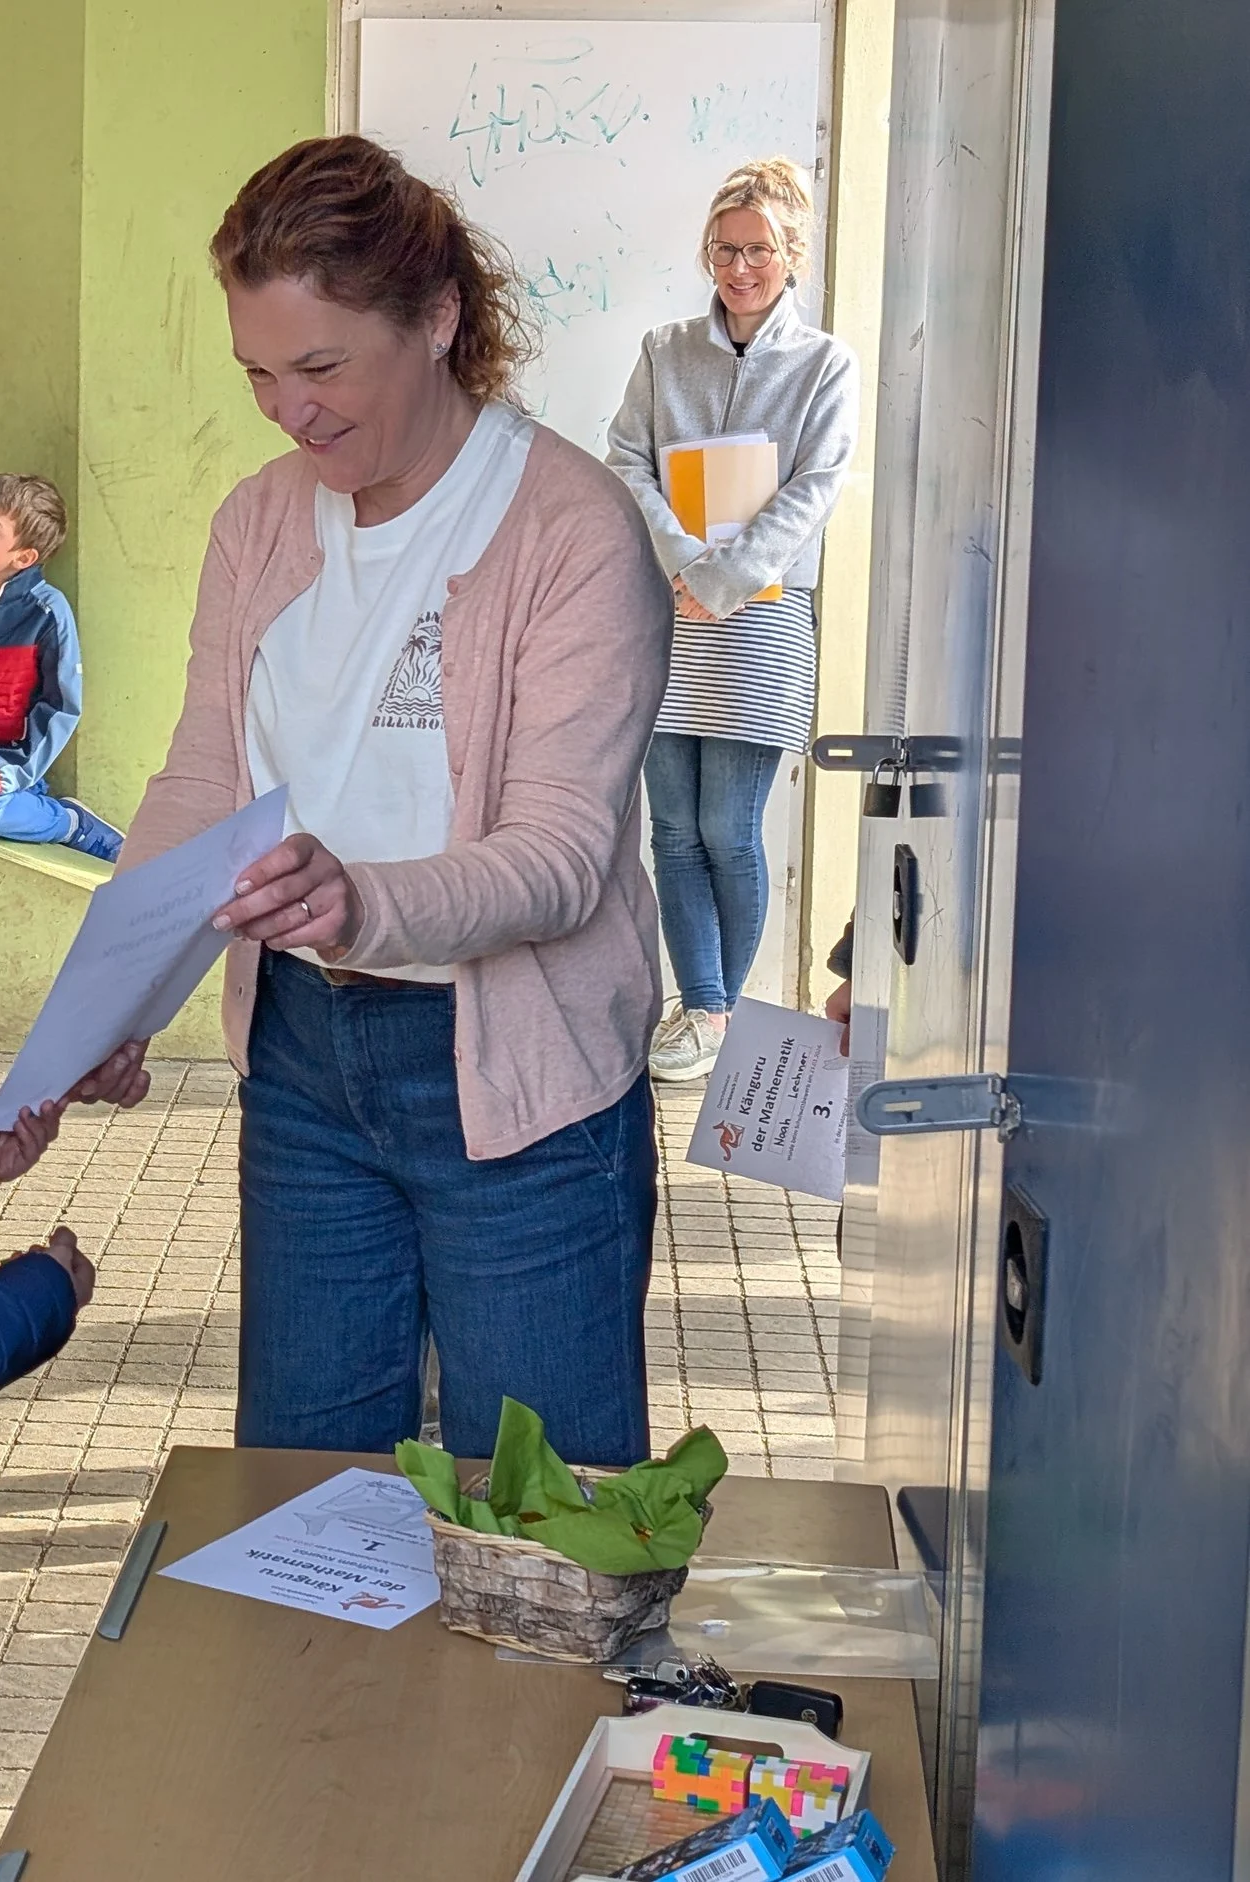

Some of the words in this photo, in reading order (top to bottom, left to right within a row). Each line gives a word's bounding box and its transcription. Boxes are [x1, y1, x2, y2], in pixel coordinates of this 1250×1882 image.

[739, 1056, 767, 1116] Känguru
[751, 1127, 767, 1152] der
[759, 1037, 795, 1125] Mathematik
[774, 1118, 791, 1148] Noah
[788, 1051, 808, 1099] Lechner
[813, 1100, 833, 1119] 3.
[362, 1539, 386, 1551] 1.
[245, 1549, 367, 1583] Mathematik
[259, 1567, 344, 1593] Känguru
[369, 1579, 406, 1591] der
